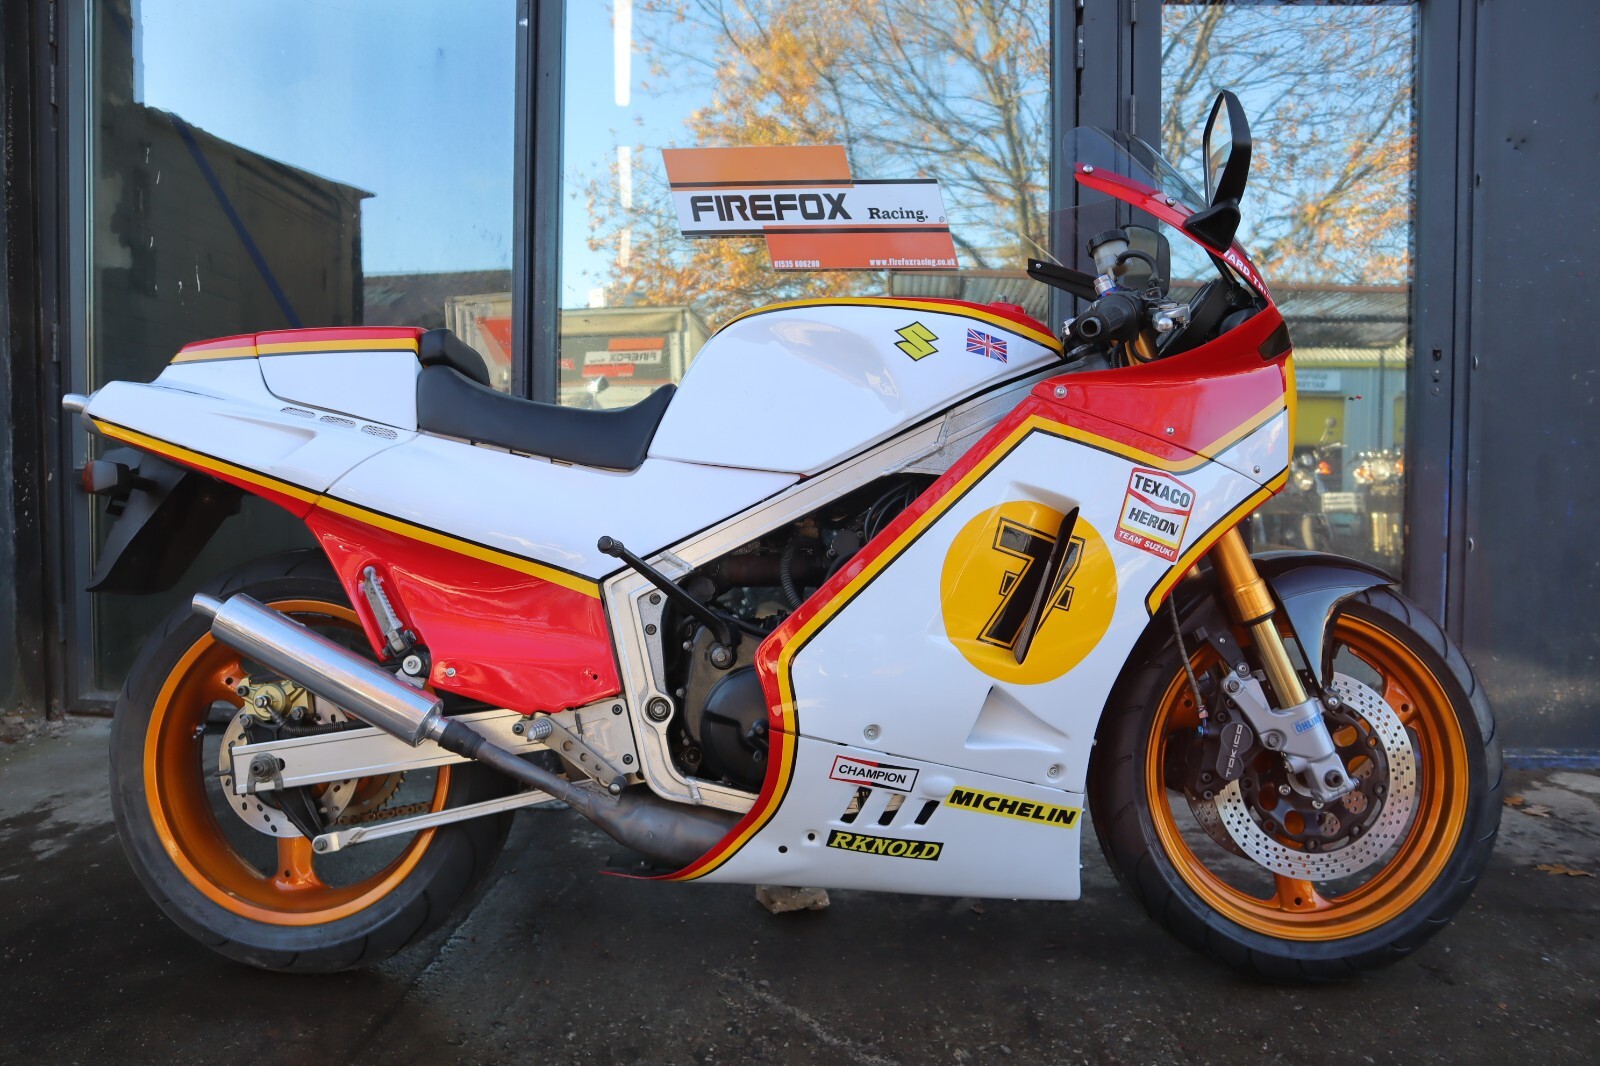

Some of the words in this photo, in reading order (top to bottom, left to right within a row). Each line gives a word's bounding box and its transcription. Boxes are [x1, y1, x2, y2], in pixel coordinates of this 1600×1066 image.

[690, 192, 852, 222] FIREFOX
[867, 206, 929, 223] Racing.
[774, 260, 793, 268] 01535
[869, 257, 956, 267] www.firefoxracing.co.uk
[1134, 474, 1191, 508] TEXACO
[1128, 507, 1180, 536] HERON
[1118, 530, 1142, 545] TEAM
[1144, 540, 1175, 557] SUZUKI
[1225, 724, 1244, 778] TOKICO
[838, 764, 907, 784] CHAMPION
[949, 789, 1077, 825] MICHELIN
[830, 831, 940, 860] RKNOLD
